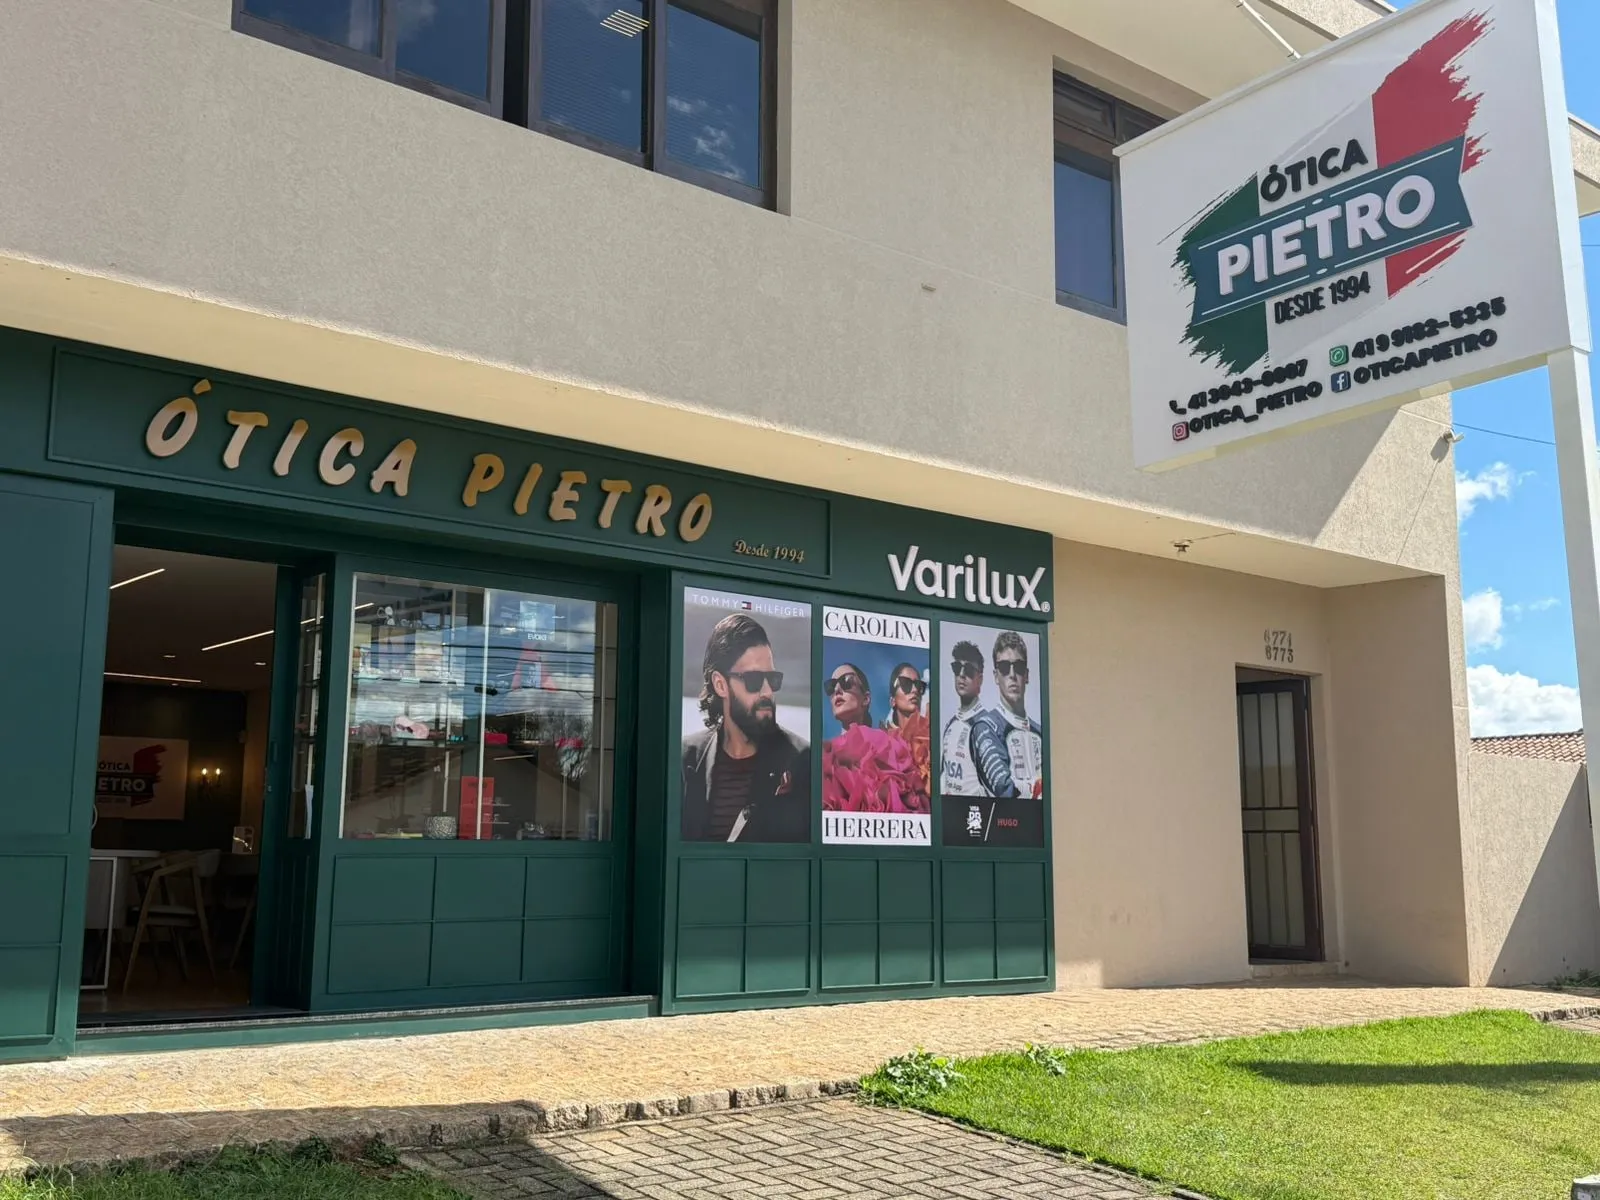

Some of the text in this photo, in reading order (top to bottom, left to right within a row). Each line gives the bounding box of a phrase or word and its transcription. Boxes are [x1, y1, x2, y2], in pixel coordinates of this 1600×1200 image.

[1260, 138, 1369, 203] ÓTICA
[1217, 174, 1436, 296] PIETRO
[1274, 271, 1371, 324] DESDE 1994
[1353, 328, 1498, 384] OTICAPIETRO
[146, 379, 713, 543] ÓTICA PIETRO
[734, 539, 805, 563] Desde 1994
[692, 594, 805, 617] TOMMY HILFIGER
[824, 611, 927, 643] CAROLINA
[99, 761, 131, 771] ÓTICA
[98, 777, 146, 792] ETRO
[824, 817, 928, 840] HERRERA
[997, 818, 1018, 827] HUGO
